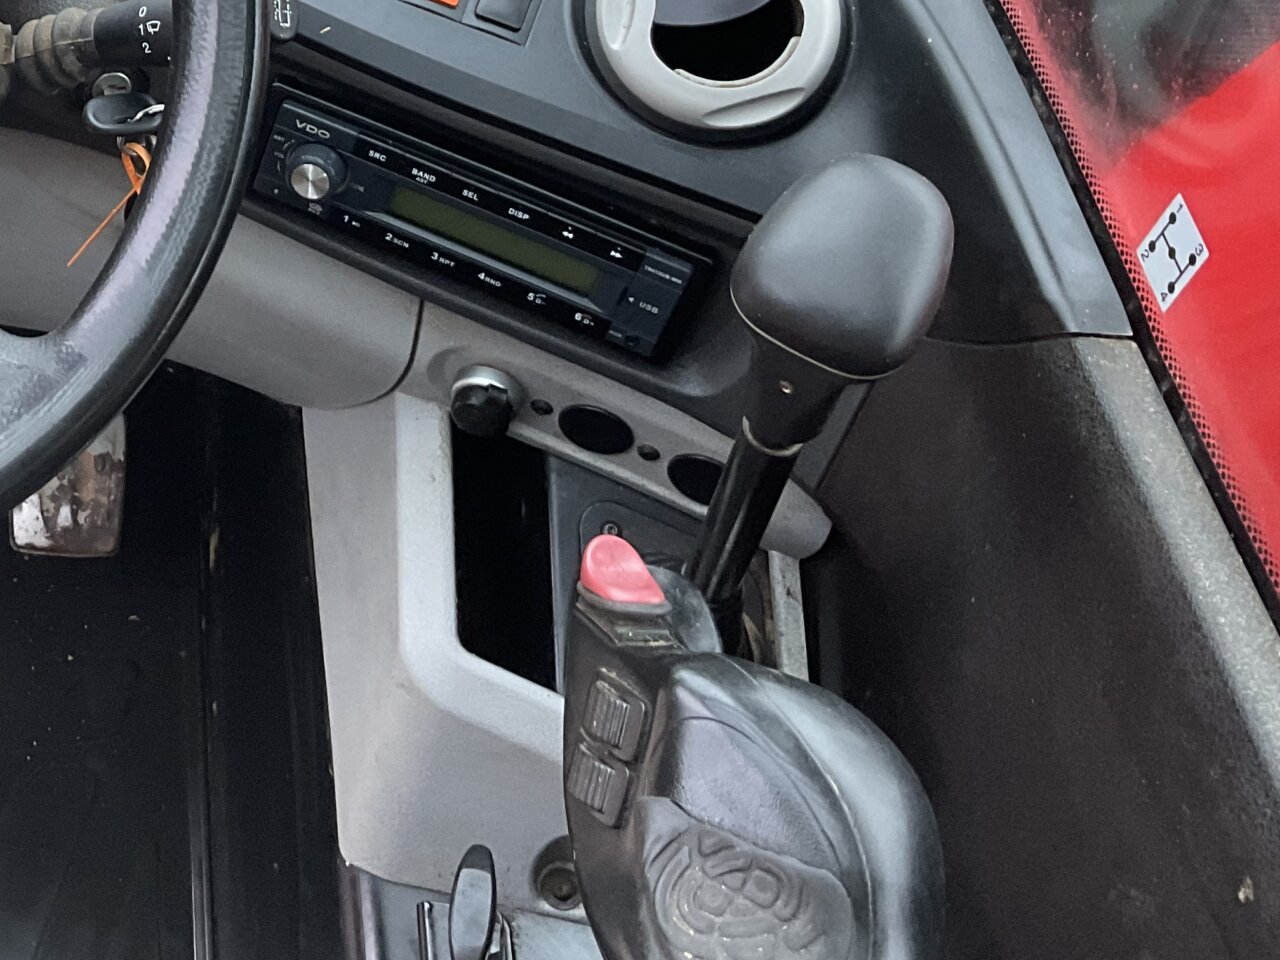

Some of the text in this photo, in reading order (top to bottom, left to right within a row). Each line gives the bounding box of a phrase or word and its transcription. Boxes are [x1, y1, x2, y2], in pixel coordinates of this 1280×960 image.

[142, 42, 152, 54] 2
[295, 118, 331, 139] VDO
[368, 149, 387, 162] SRC
[411, 167, 436, 183] BAND
[462, 189, 480, 201] SEL
[343, 214, 350, 223] 1
[507, 207, 530, 220] DISP
[384, 232, 393, 241] 2
[1194, 243, 1205, 257] 3
[431, 251, 456, 267] 3 RPT
[1140, 250, 1150, 263] 2
[477, 271, 486, 281] 4
[526, 292, 535, 301] 5
[1160, 291, 1169, 303] 4
[639, 301, 659, 314] USB
[574, 311, 582, 321] 6
